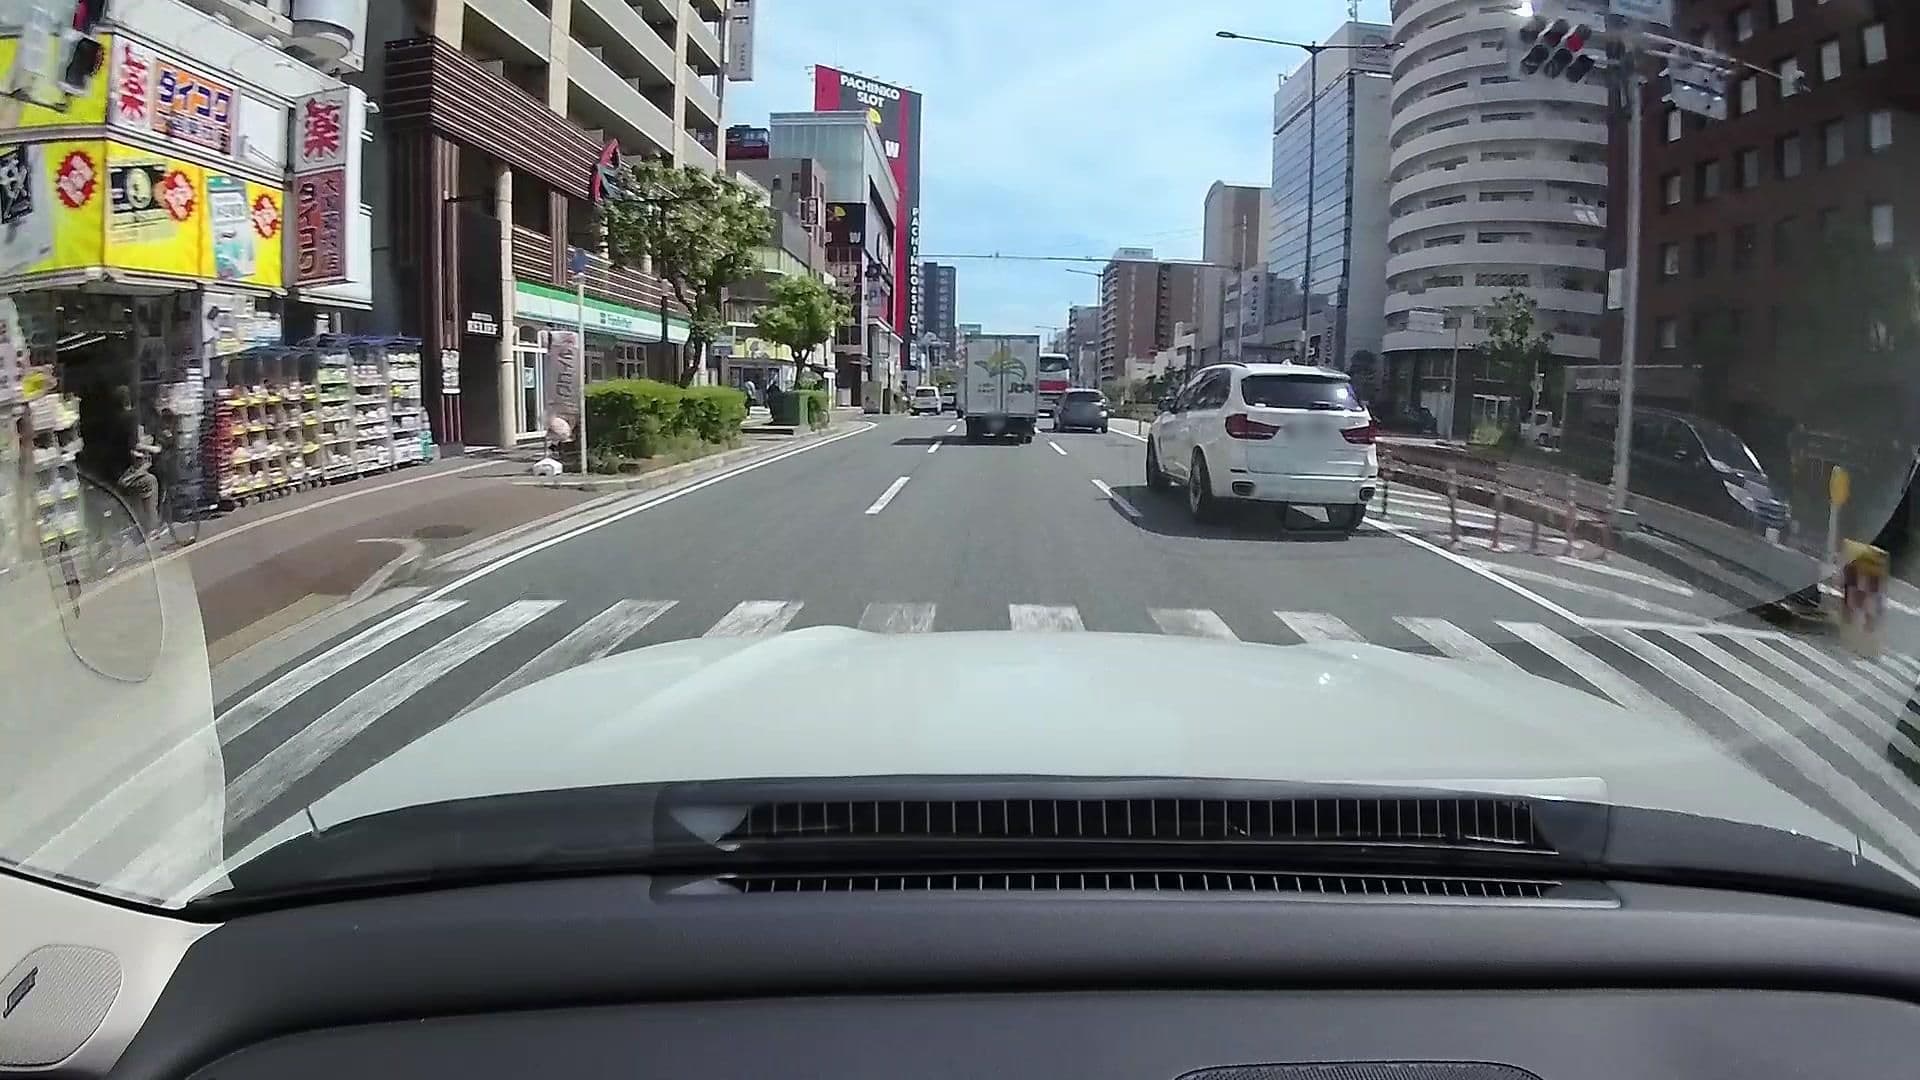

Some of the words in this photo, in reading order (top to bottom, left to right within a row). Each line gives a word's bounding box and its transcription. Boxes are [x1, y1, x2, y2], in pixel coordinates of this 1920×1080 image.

[840, 74, 901, 101] PACHINKO
[857, 91, 885, 107] SLOT
[304, 98, 341, 160] 薬
